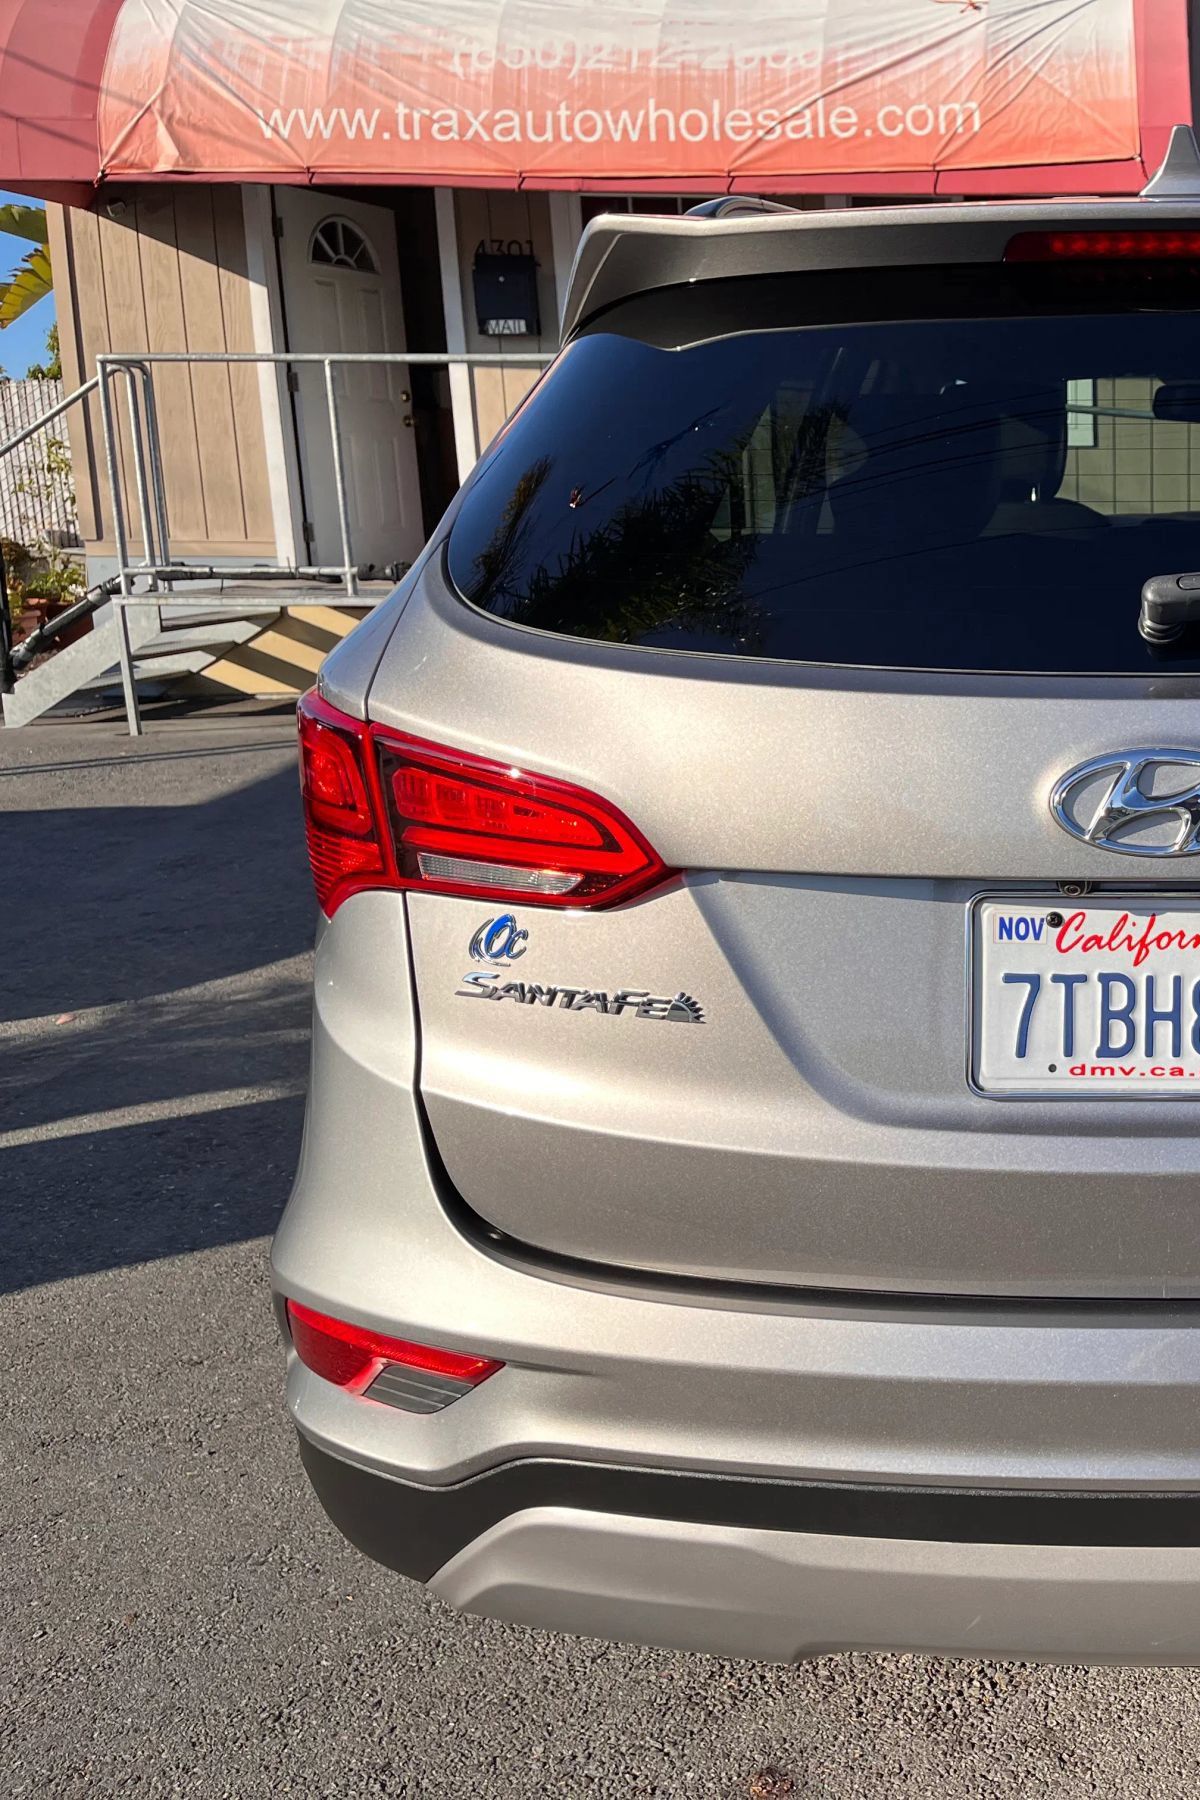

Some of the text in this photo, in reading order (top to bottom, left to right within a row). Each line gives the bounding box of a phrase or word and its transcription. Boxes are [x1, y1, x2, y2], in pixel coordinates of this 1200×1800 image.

[259, 98, 981, 142] www.traxautowholesale.com
[487, 319, 528, 334] MAIL
[998, 916, 1045, 941] NOV
